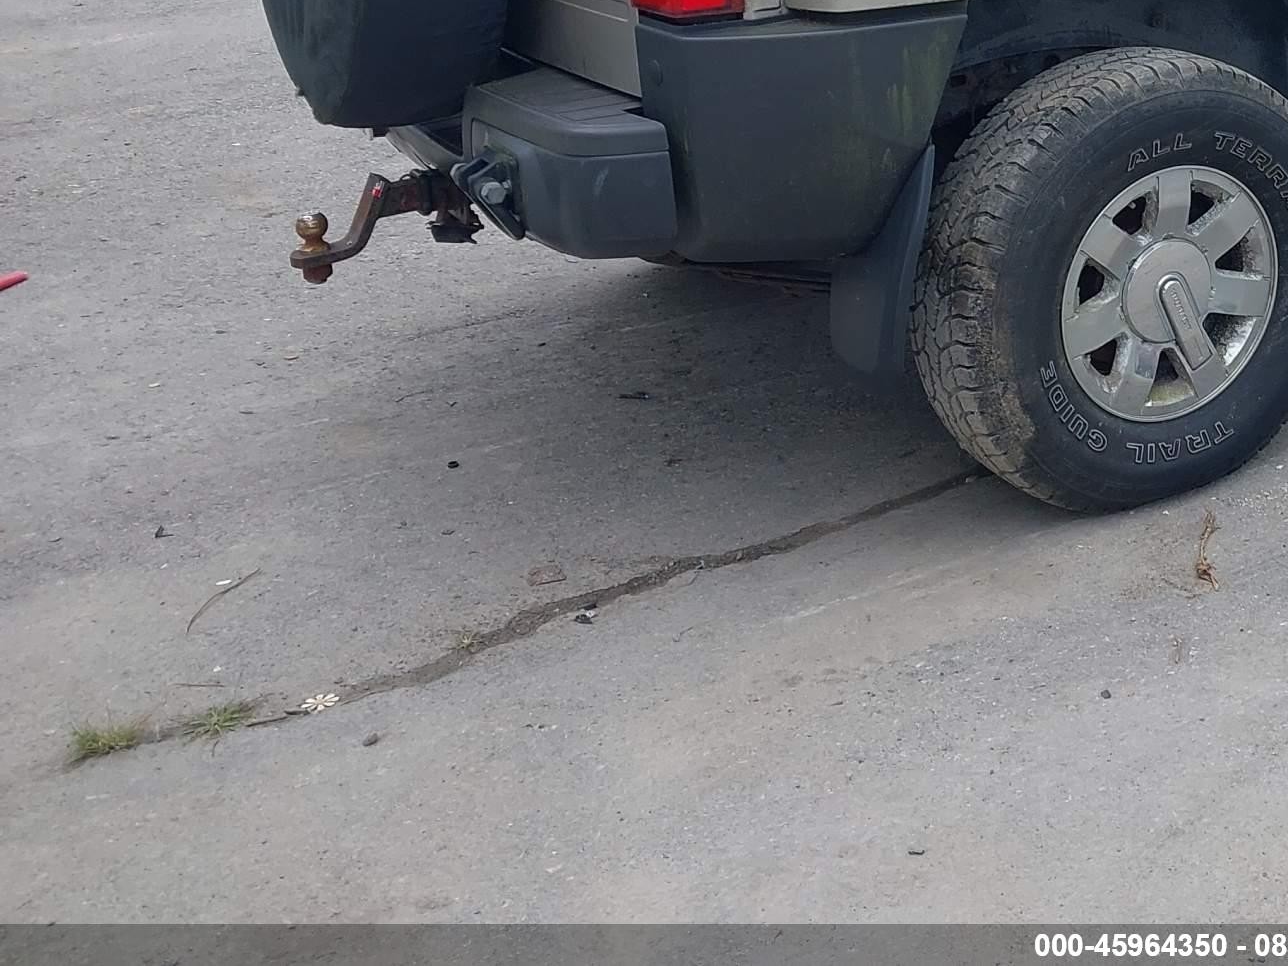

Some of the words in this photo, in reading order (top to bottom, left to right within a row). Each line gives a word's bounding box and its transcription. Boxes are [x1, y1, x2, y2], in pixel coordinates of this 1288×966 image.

[1127, 133, 1193, 172] ALL
[1039, 360, 1107, 452] GUIDE
[1126, 421, 1234, 463] TRAIL
